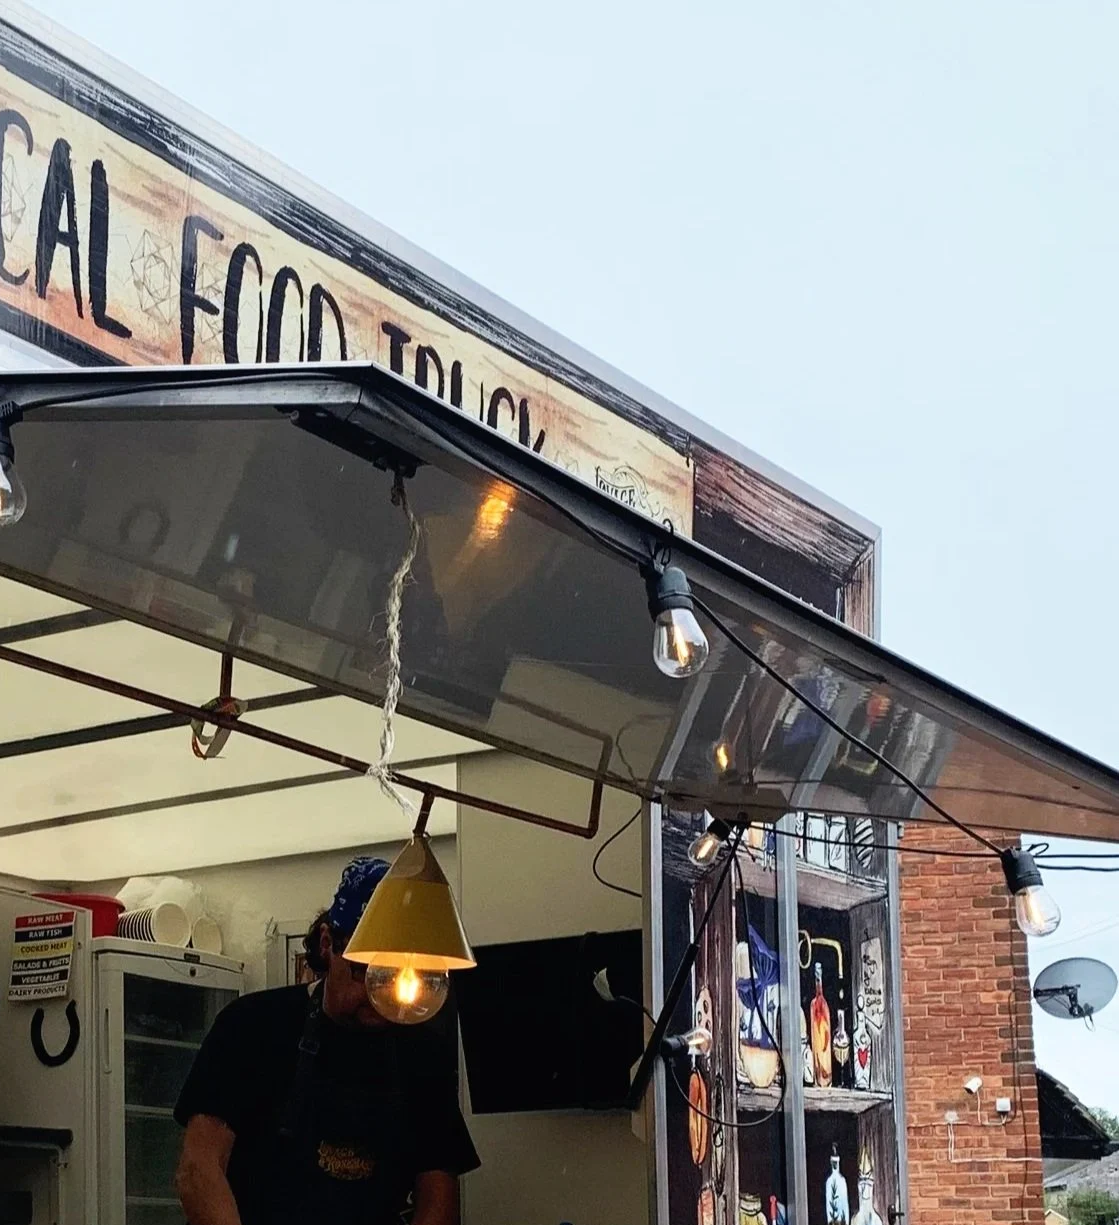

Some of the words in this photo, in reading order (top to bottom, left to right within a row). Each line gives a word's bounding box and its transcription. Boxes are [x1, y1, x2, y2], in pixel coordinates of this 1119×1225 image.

[27, 915, 44, 924] RAW
[45, 914, 63, 922] MEAT
[28, 931, 45, 939] RAW
[46, 929, 62, 937] FISH
[20, 945, 49, 954] COOKED
[50, 942, 67, 950] MEAT
[13, 961, 41, 970] SALADS
[48, 957, 69, 967] FRUITS
[21, 973, 61, 984] VEGETABLES
[8, 988, 32, 997] DAIRY
[33, 985, 65, 995] PRODUCTS
